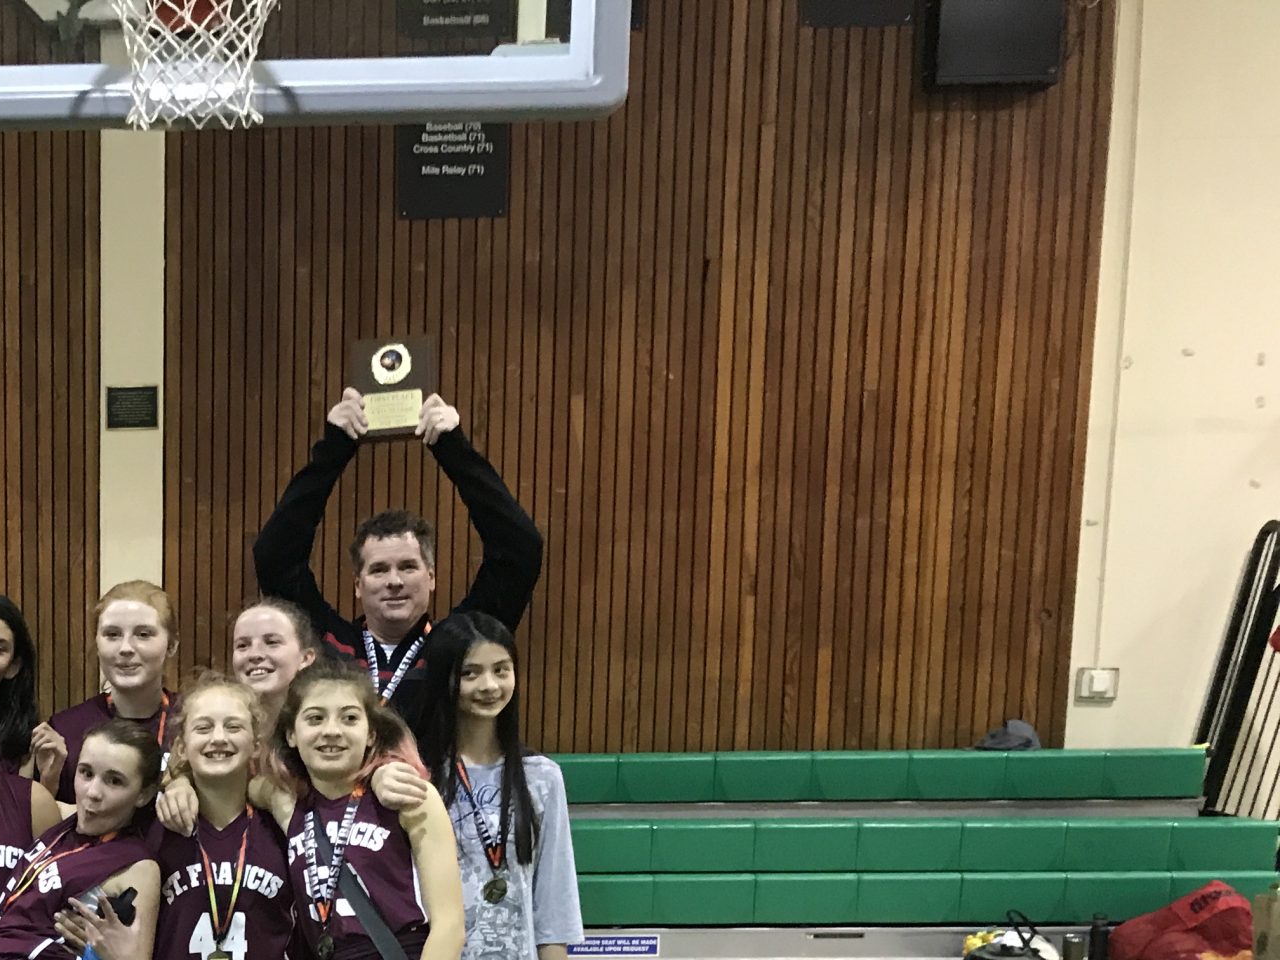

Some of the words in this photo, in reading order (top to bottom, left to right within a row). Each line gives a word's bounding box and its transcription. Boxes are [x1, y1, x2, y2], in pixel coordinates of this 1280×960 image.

[422, 132, 467, 142] Basketball
[468, 132, 485, 142] (71)
[413, 144, 439, 153] Cross
[440, 143, 474, 153] Country
[477, 142, 493, 153] (71)
[421, 165, 440, 175] Mile
[442, 164, 466, 176] Relay
[468, 164, 484, 175] (71)
[326, 804, 359, 899] BASKETBALL
[161, 870, 189, 905] ST.
